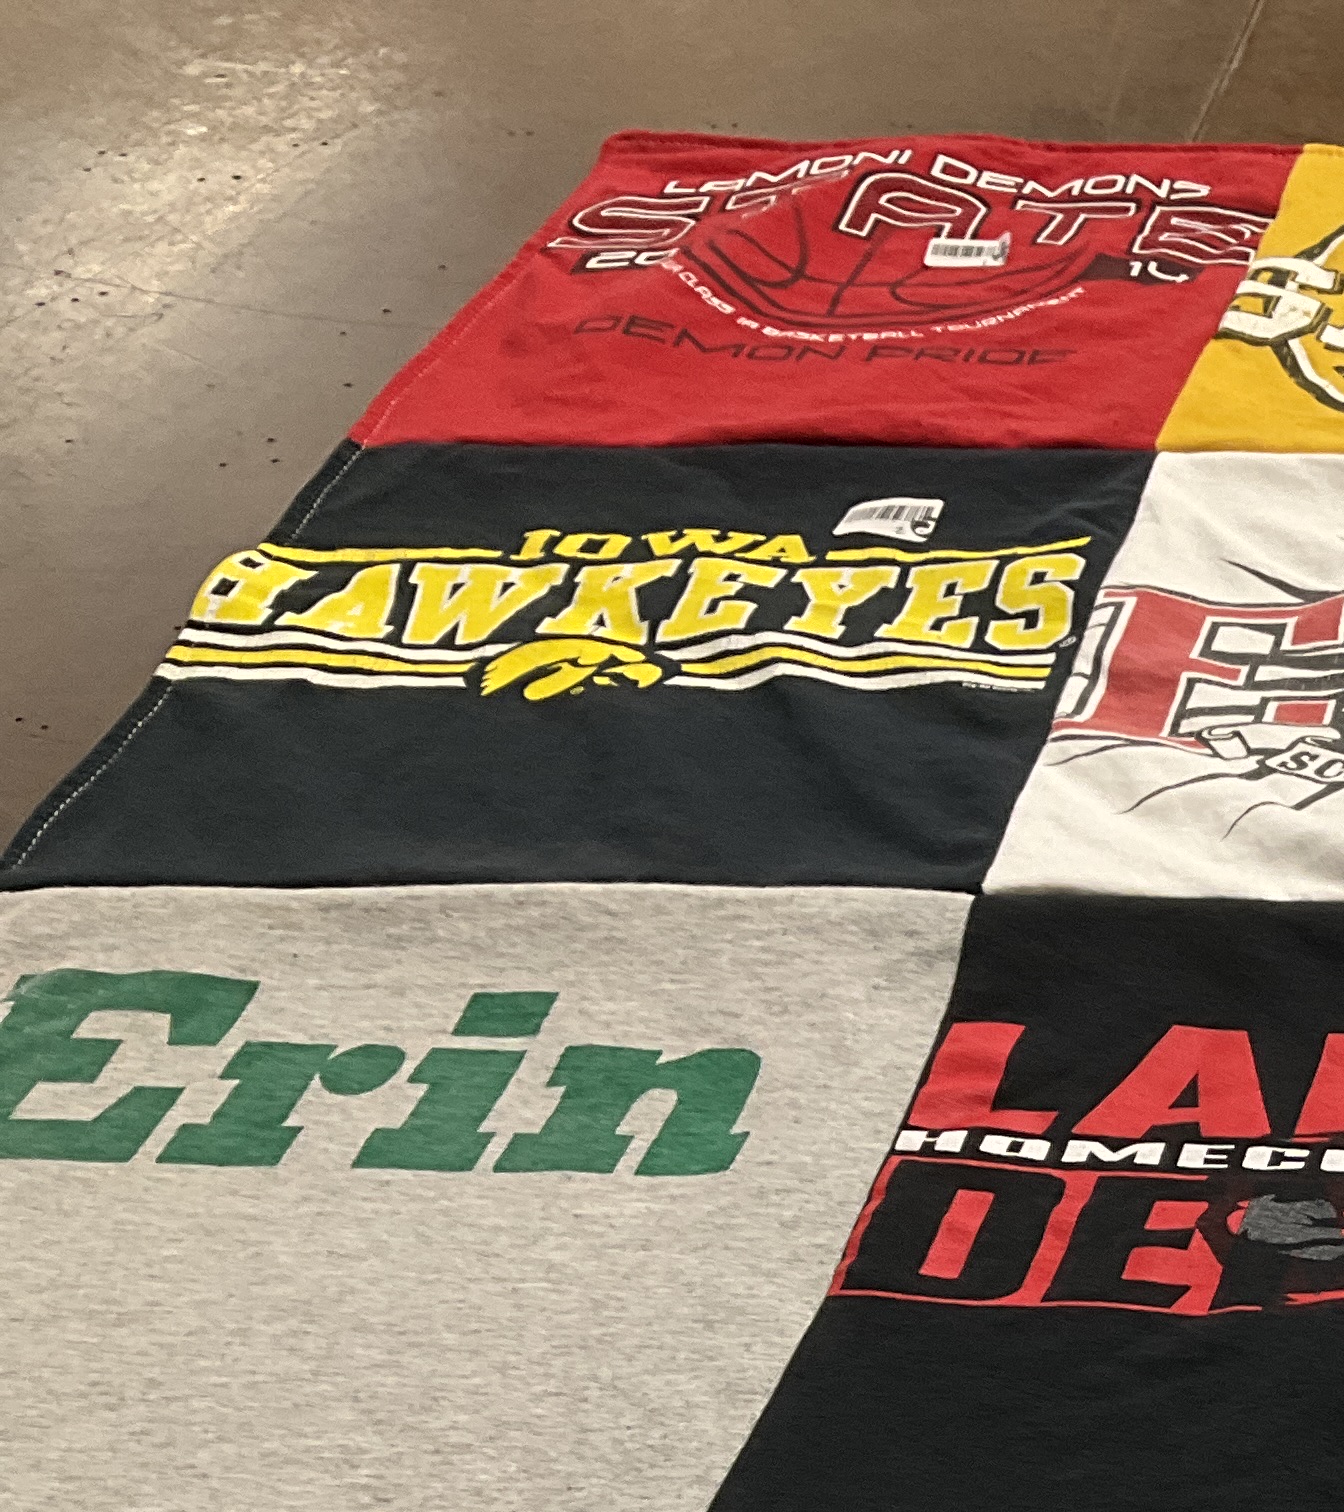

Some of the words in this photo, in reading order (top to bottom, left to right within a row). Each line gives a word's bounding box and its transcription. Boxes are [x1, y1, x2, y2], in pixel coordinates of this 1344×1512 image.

[663, 149, 913, 193] LAMONI
[930, 153, 1212, 200] DEMONS
[574, 314, 849, 363] DEMON
[862, 343, 1078, 367] PRIDE
[507, 528, 816, 563] IOWA
[188, 549, 1082, 651] HAWKEYES
[0, 968, 763, 1177] Erin
